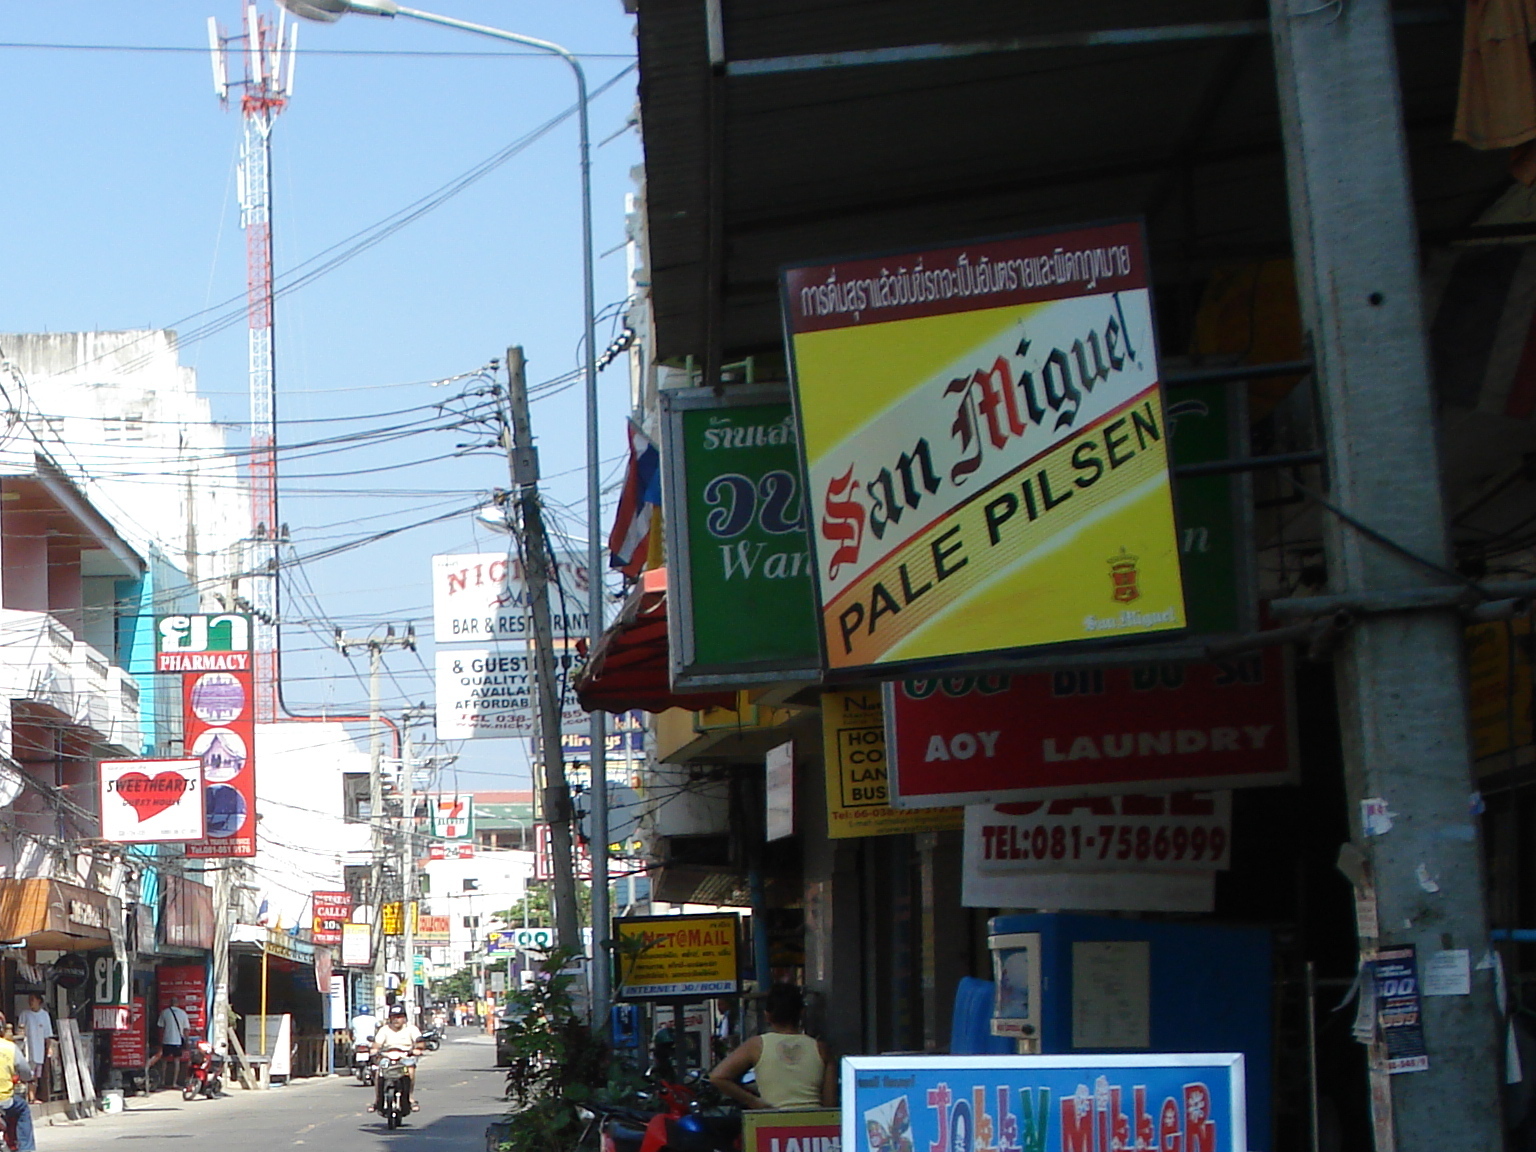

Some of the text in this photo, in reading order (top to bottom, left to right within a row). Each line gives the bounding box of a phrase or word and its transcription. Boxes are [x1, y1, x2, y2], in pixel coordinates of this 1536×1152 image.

[822, 292, 1136, 581] San Miguel
[839, 402, 1161, 655] PALE PILSEN
[159, 615, 248, 653] ยา
[452, 618, 479, 635] BAR
[160, 654, 248, 671] PHARMACY
[452, 659, 464, 675] &
[460, 675, 529, 686] QUALITY
[924, 724, 1275, 763] AOY LAUNDRY
[107, 779, 197, 793] SWEETHEARTS
[317, 906, 348, 917] CALLS
[625, 984, 676, 995] INTERNET
